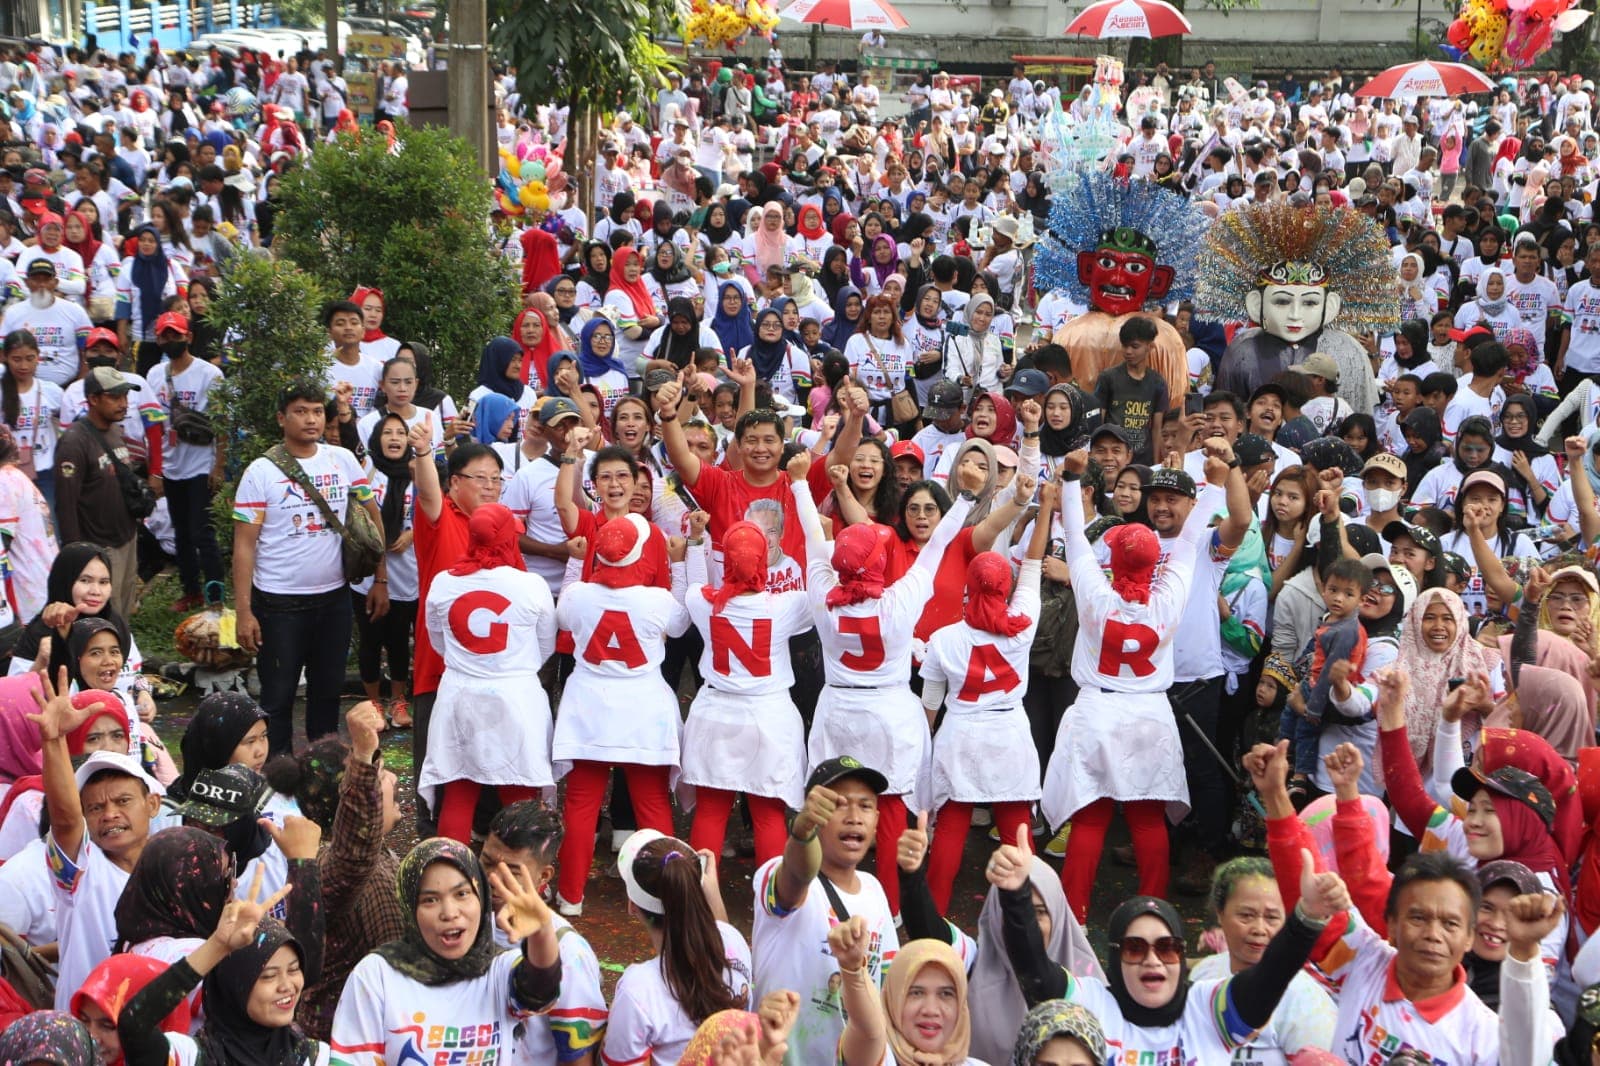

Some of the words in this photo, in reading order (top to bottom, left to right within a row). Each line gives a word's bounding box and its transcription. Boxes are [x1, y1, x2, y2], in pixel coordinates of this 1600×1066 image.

[191, 782, 242, 803] ORT
[427, 1021, 500, 1048] BOGOR
[434, 1049, 501, 1066] SEHA
